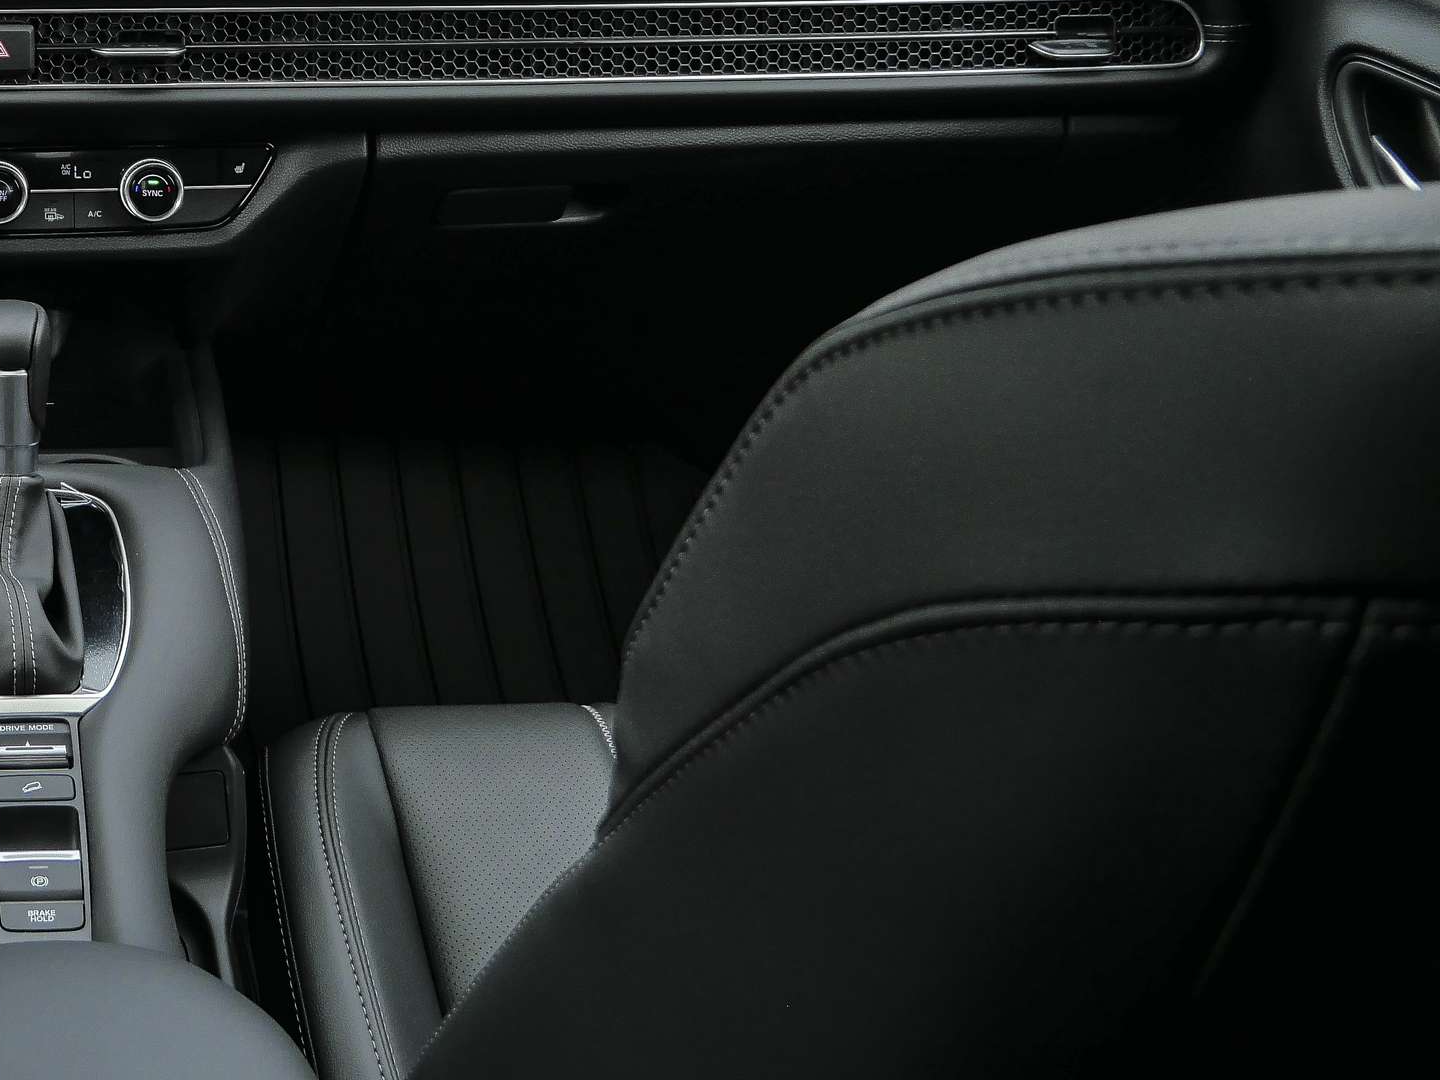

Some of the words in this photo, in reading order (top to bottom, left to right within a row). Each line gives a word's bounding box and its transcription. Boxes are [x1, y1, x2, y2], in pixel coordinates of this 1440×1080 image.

[73, 165, 92, 179] Lo
[142, 189, 164, 198] SYNC
[87, 210, 103, 218] A/C
[0, 724, 26, 732] DRIVE
[28, 723, 55, 732] MODE
[27, 909, 56, 918] BRAKE
[29, 915, 55, 923] HOLD
